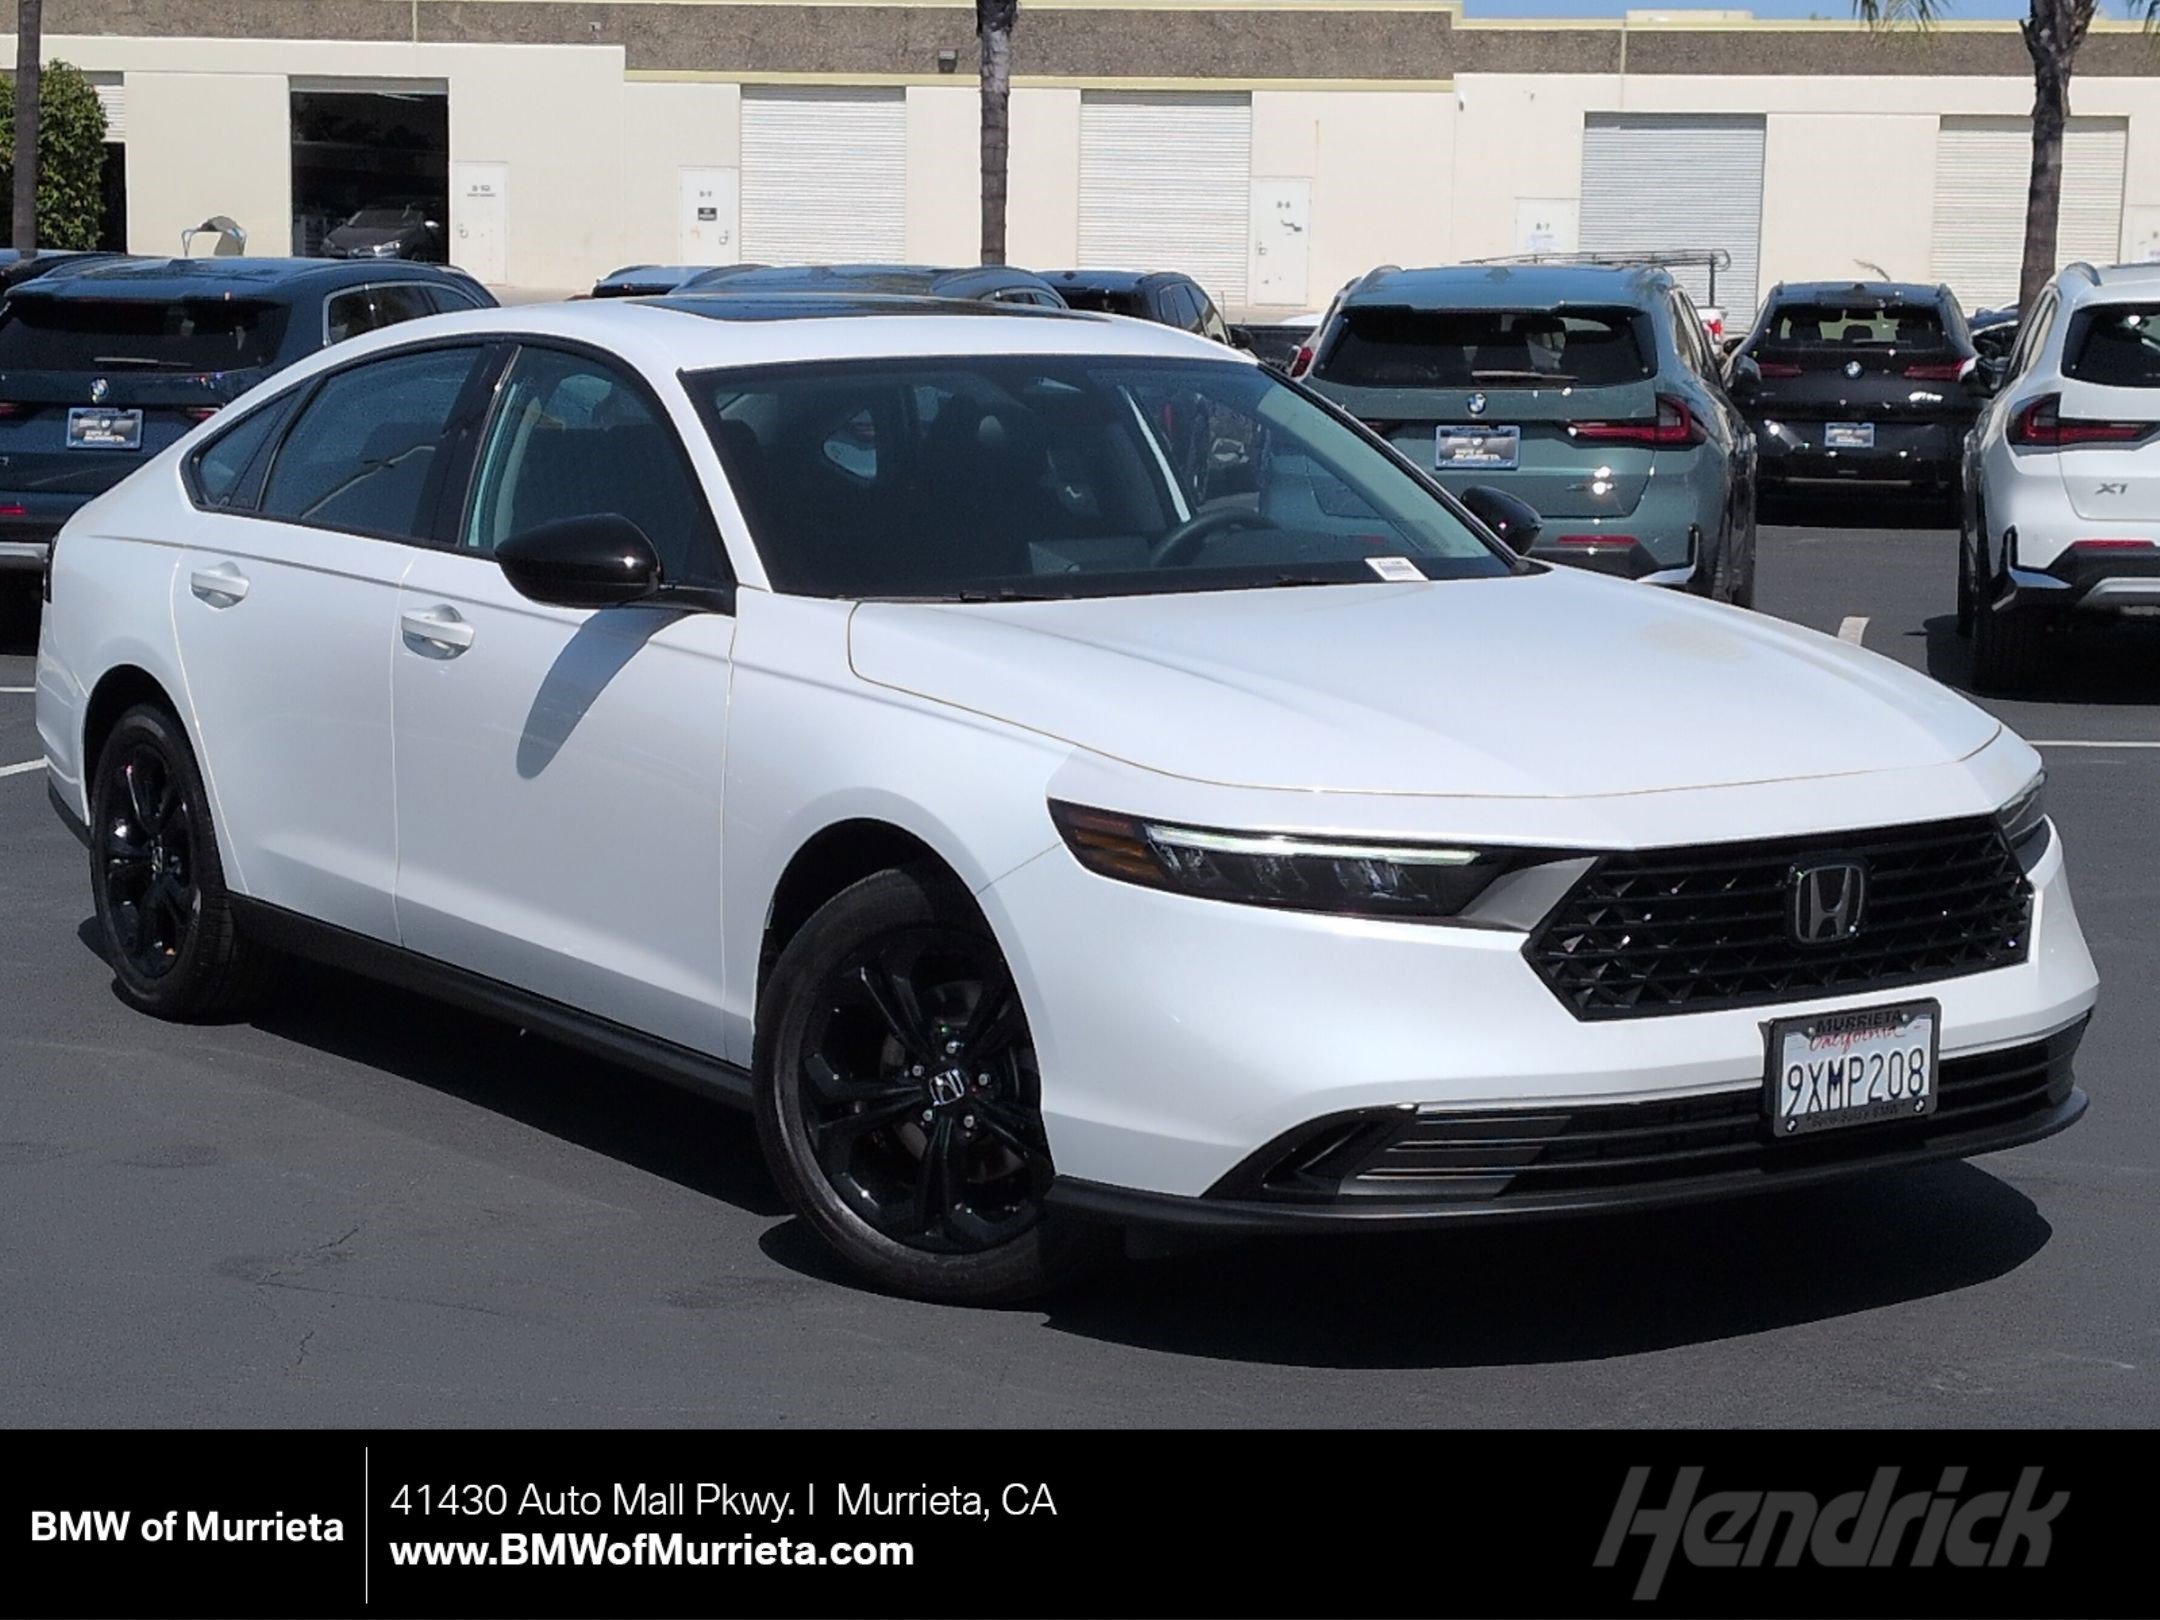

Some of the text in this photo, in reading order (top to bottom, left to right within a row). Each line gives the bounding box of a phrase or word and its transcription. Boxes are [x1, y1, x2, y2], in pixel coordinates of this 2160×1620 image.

[2094, 482, 2128, 495] X1
[1816, 1010, 1902, 1033] MURRIETA
[1786, 1047, 1925, 1118] 9XMP208
